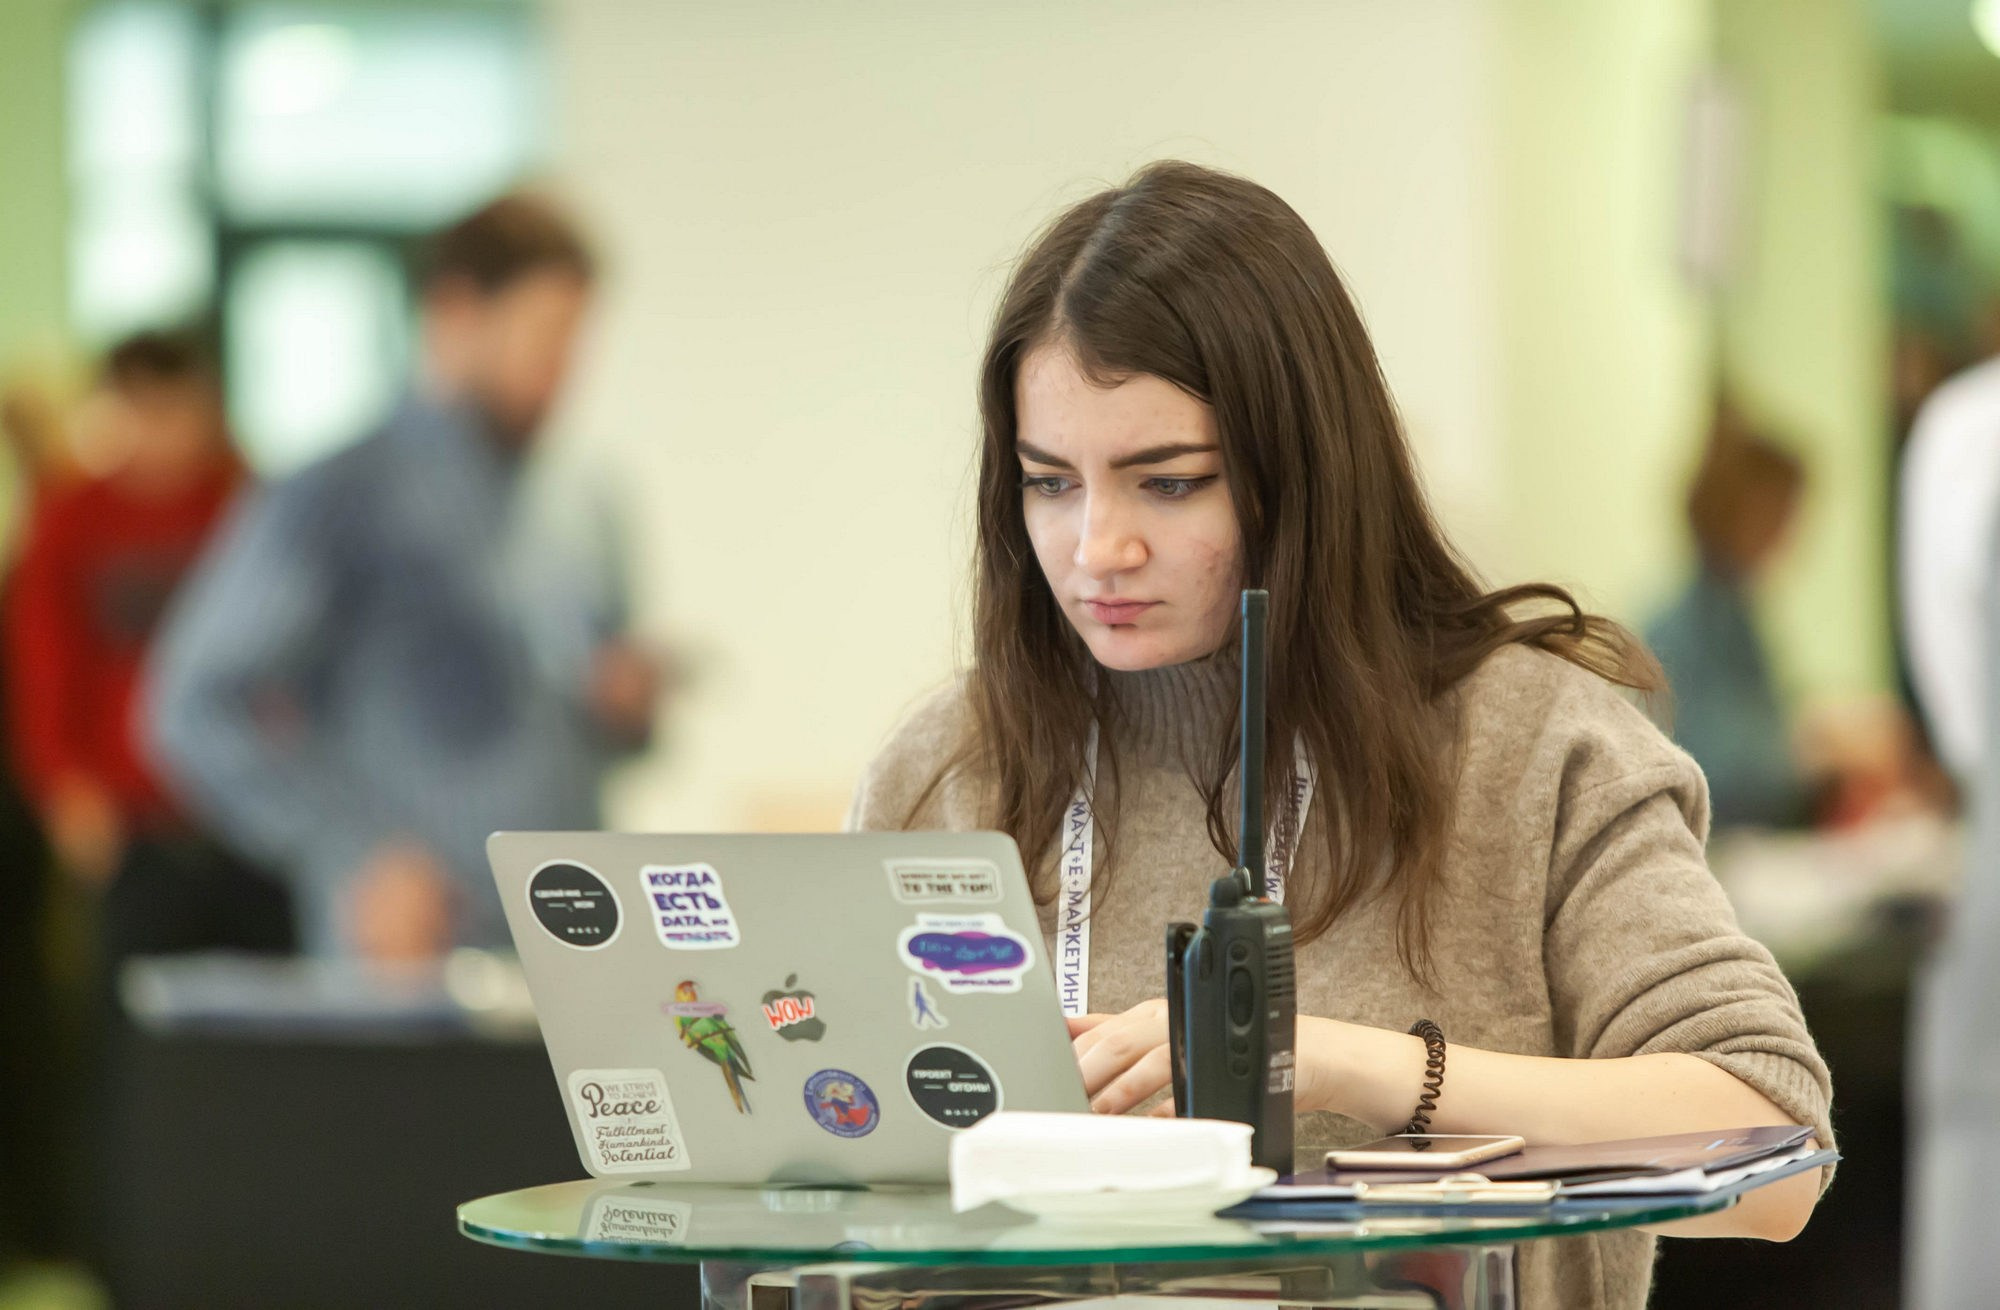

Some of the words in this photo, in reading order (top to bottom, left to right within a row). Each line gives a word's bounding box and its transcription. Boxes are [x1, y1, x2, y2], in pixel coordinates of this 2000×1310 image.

[648, 871, 714, 887] КОГДА
[927, 883, 953, 894] THE
[653, 892, 721, 911] ЕСТЬ
[1063, 887, 1082, 1013] МАРКЕТИНГ
[763, 997, 813, 1028] WOW
[912, 1069, 952, 1080] ПРОЕКТ
[604, 1084, 620, 1093] WE
[623, 1081, 655, 1092] STRIVE
[581, 1082, 661, 1118] Peace
[601, 1146, 675, 1165] Potential
